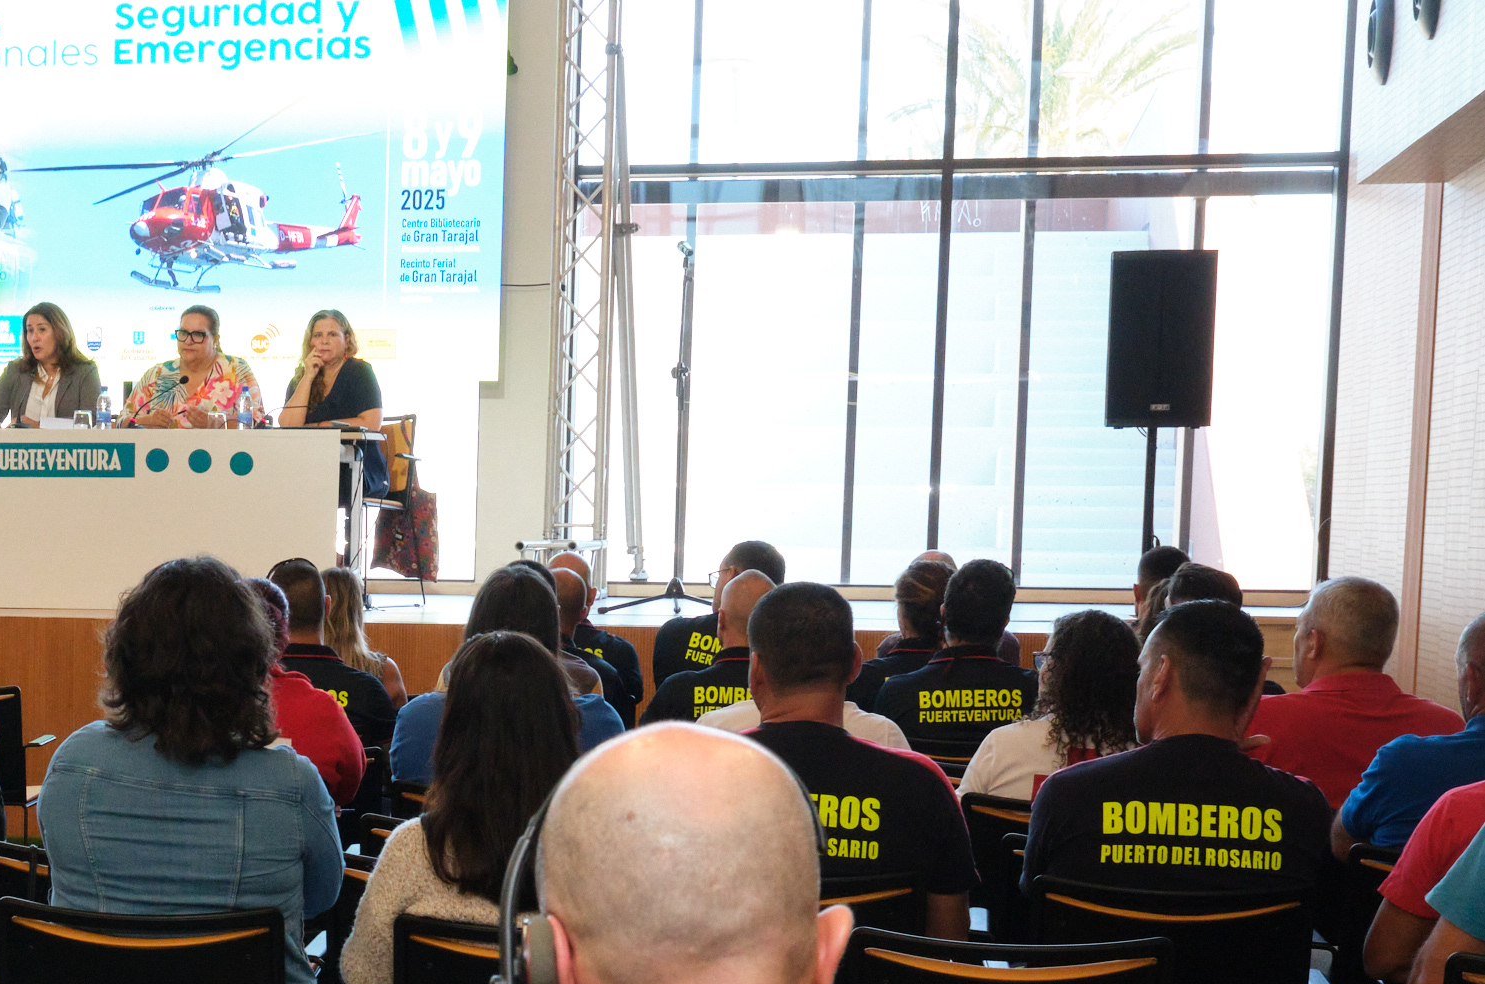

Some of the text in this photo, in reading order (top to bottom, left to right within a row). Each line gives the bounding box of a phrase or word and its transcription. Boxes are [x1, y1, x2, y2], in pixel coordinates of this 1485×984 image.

[115, 0, 360, 37] Seguridad y
[113, 28, 372, 71] Emergencias
[434, 121, 453, 160] y
[401, 159, 482, 197] mayo
[401, 188, 446, 211] 2025
[401, 217, 481, 229] Centro Bibliotecario
[401, 229, 479, 245] de Gran Tarajal
[400, 258, 456, 269] Recinto Ferial
[400, 269, 477, 286] de Gran Tarajal
[684, 648, 714, 666] FUER
[918, 688, 1023, 709] BOMBEROS
[918, 708, 1023, 723] FUERTEVENTURA
[1102, 800, 1283, 843] BOMBEROS
[827, 837, 879, 860] SARIO
[1100, 844, 1283, 871] PUERTO DEL ROSARIO
